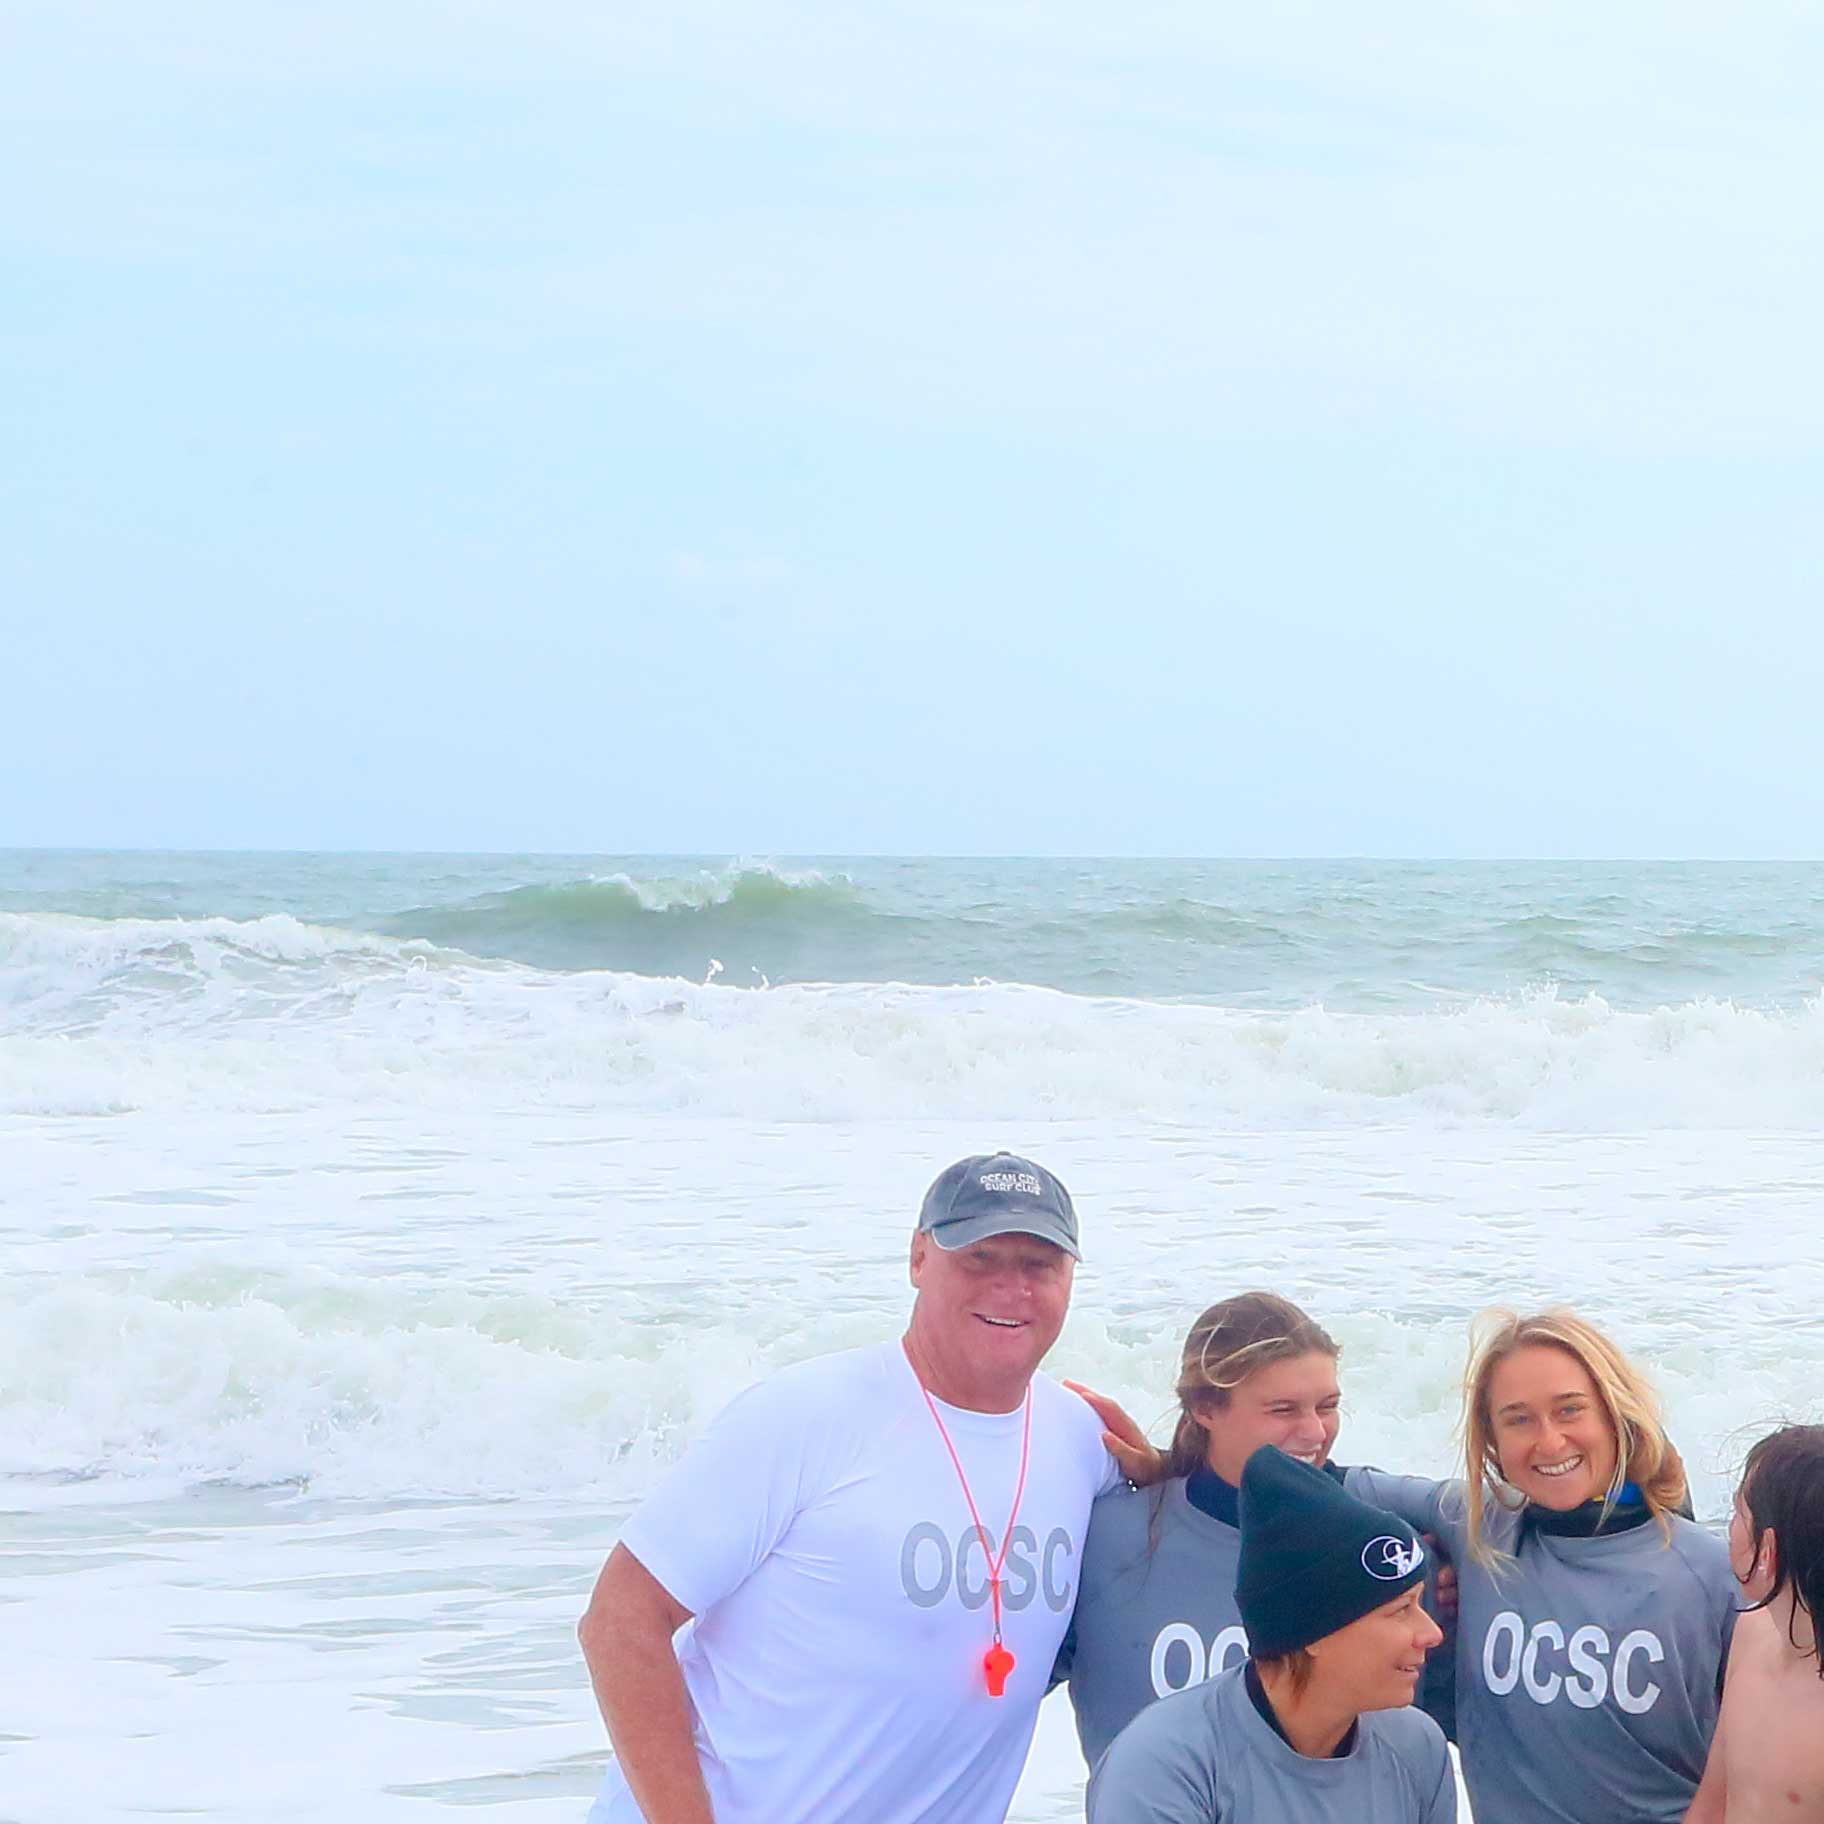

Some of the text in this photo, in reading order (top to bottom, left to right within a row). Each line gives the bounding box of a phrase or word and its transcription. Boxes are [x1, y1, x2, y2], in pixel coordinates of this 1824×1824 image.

[980, 1172, 1017, 1184] OCEAN
[984, 1183, 1012, 1191] SURF
[900, 1521, 1072, 1613] OCSC
[1483, 1611, 1665, 1715] OCSC
